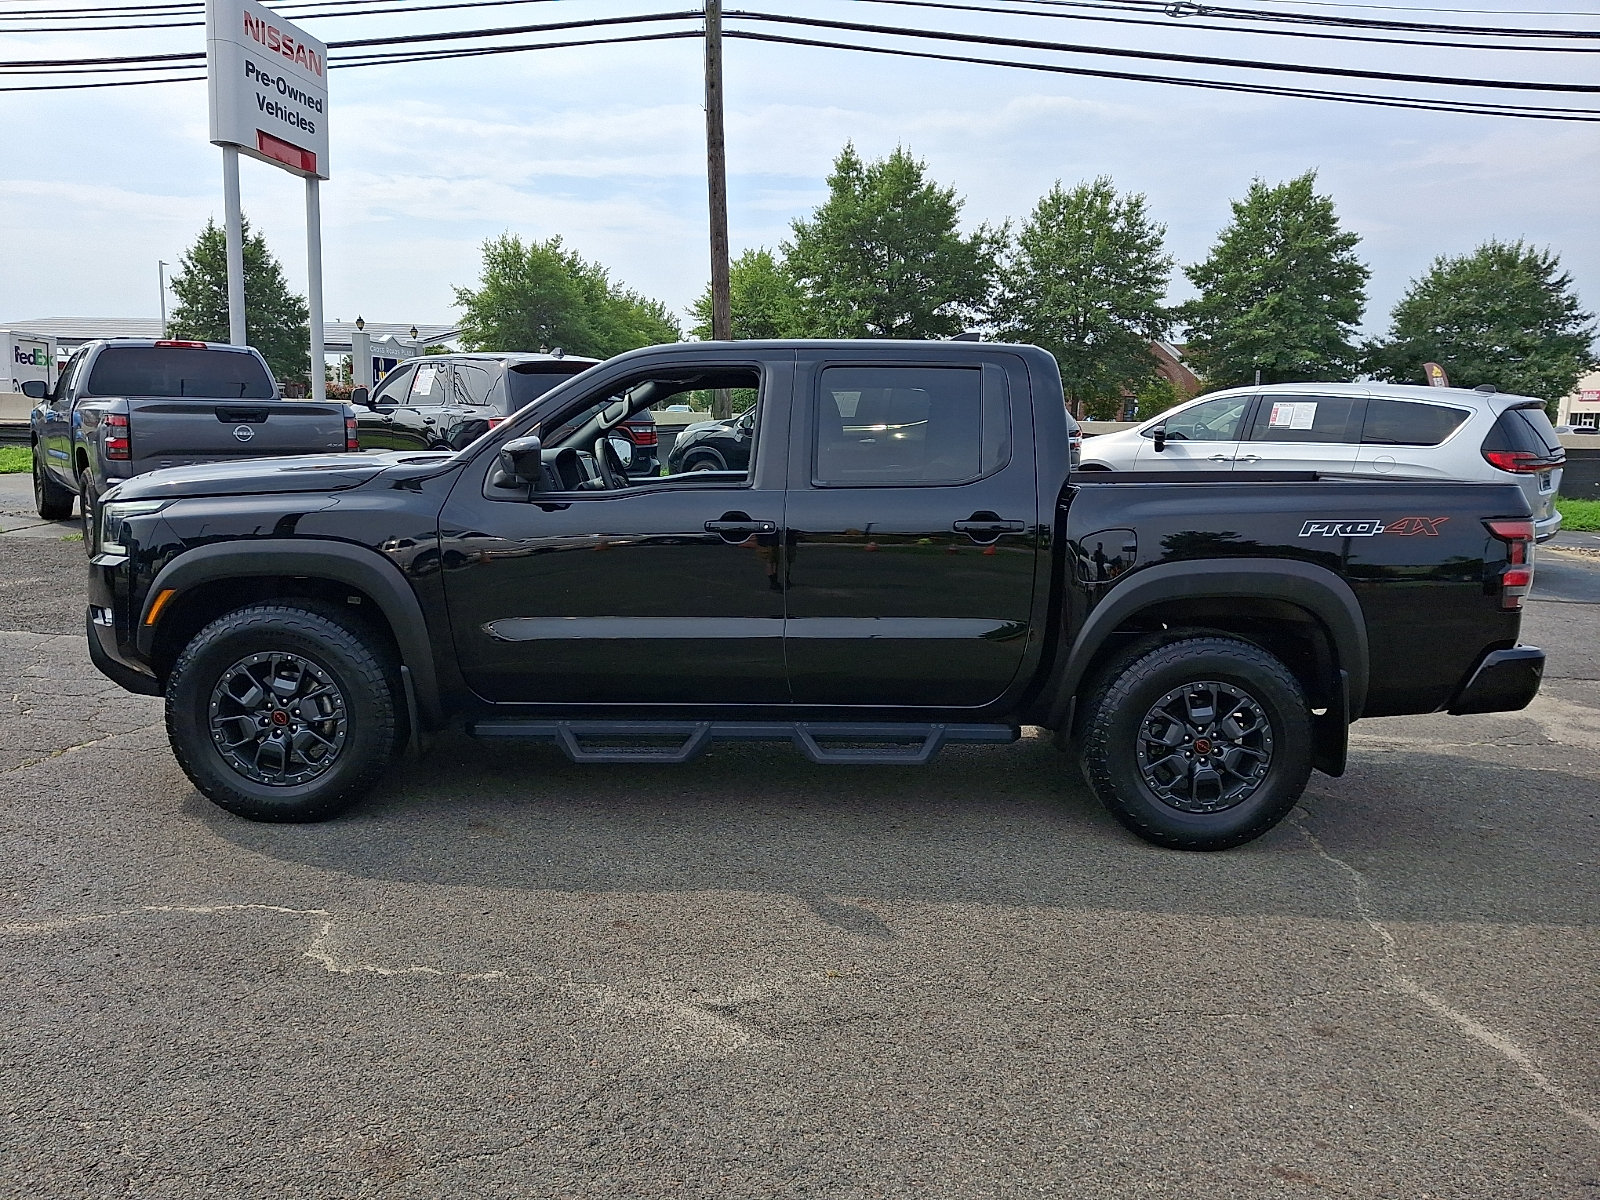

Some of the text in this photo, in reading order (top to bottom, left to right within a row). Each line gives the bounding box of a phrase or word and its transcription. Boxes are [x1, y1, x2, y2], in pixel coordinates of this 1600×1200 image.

[243, 10, 322, 77] NISSAN
[245, 59, 323, 114] Pre-Owned
[256, 92, 316, 135] Vehicles
[14, 345, 55, 367] FedEx
[1298, 516, 1450, 537] PRO-4X
